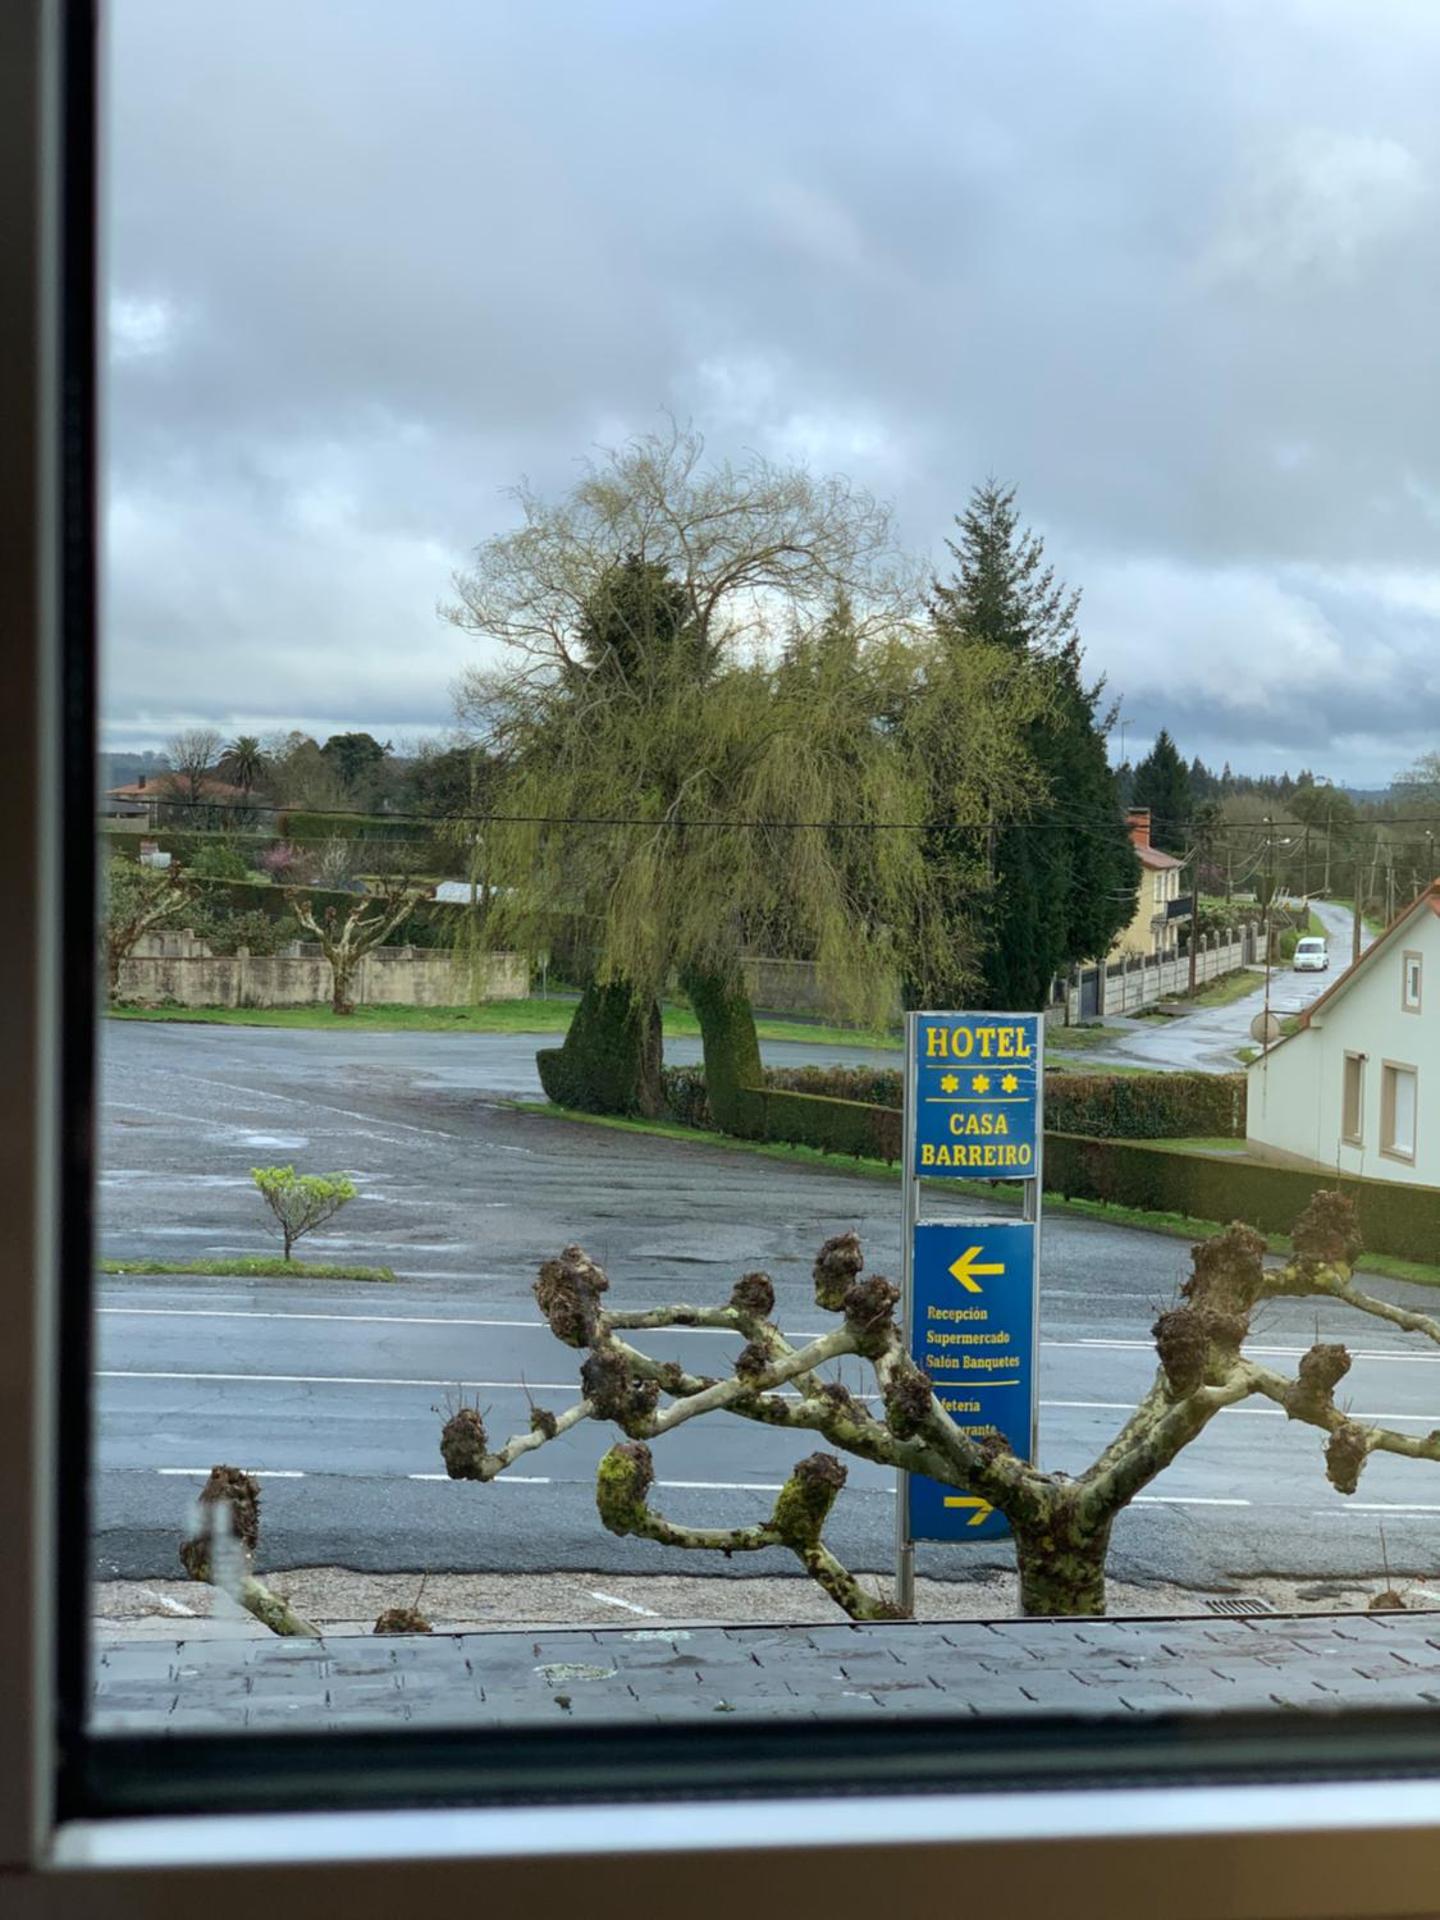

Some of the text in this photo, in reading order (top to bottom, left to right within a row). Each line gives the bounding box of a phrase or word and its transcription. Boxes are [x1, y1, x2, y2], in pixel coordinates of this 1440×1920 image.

[926, 1027, 1030, 1057] HOTEL
[950, 1113, 1008, 1135] CASA
[921, 1144, 1031, 1166] BARREIRO
[927, 1306, 988, 1323] Recepción
[927, 1330, 1010, 1347] Supermercado
[927, 1354, 1020, 1371] Salón Banquetes
